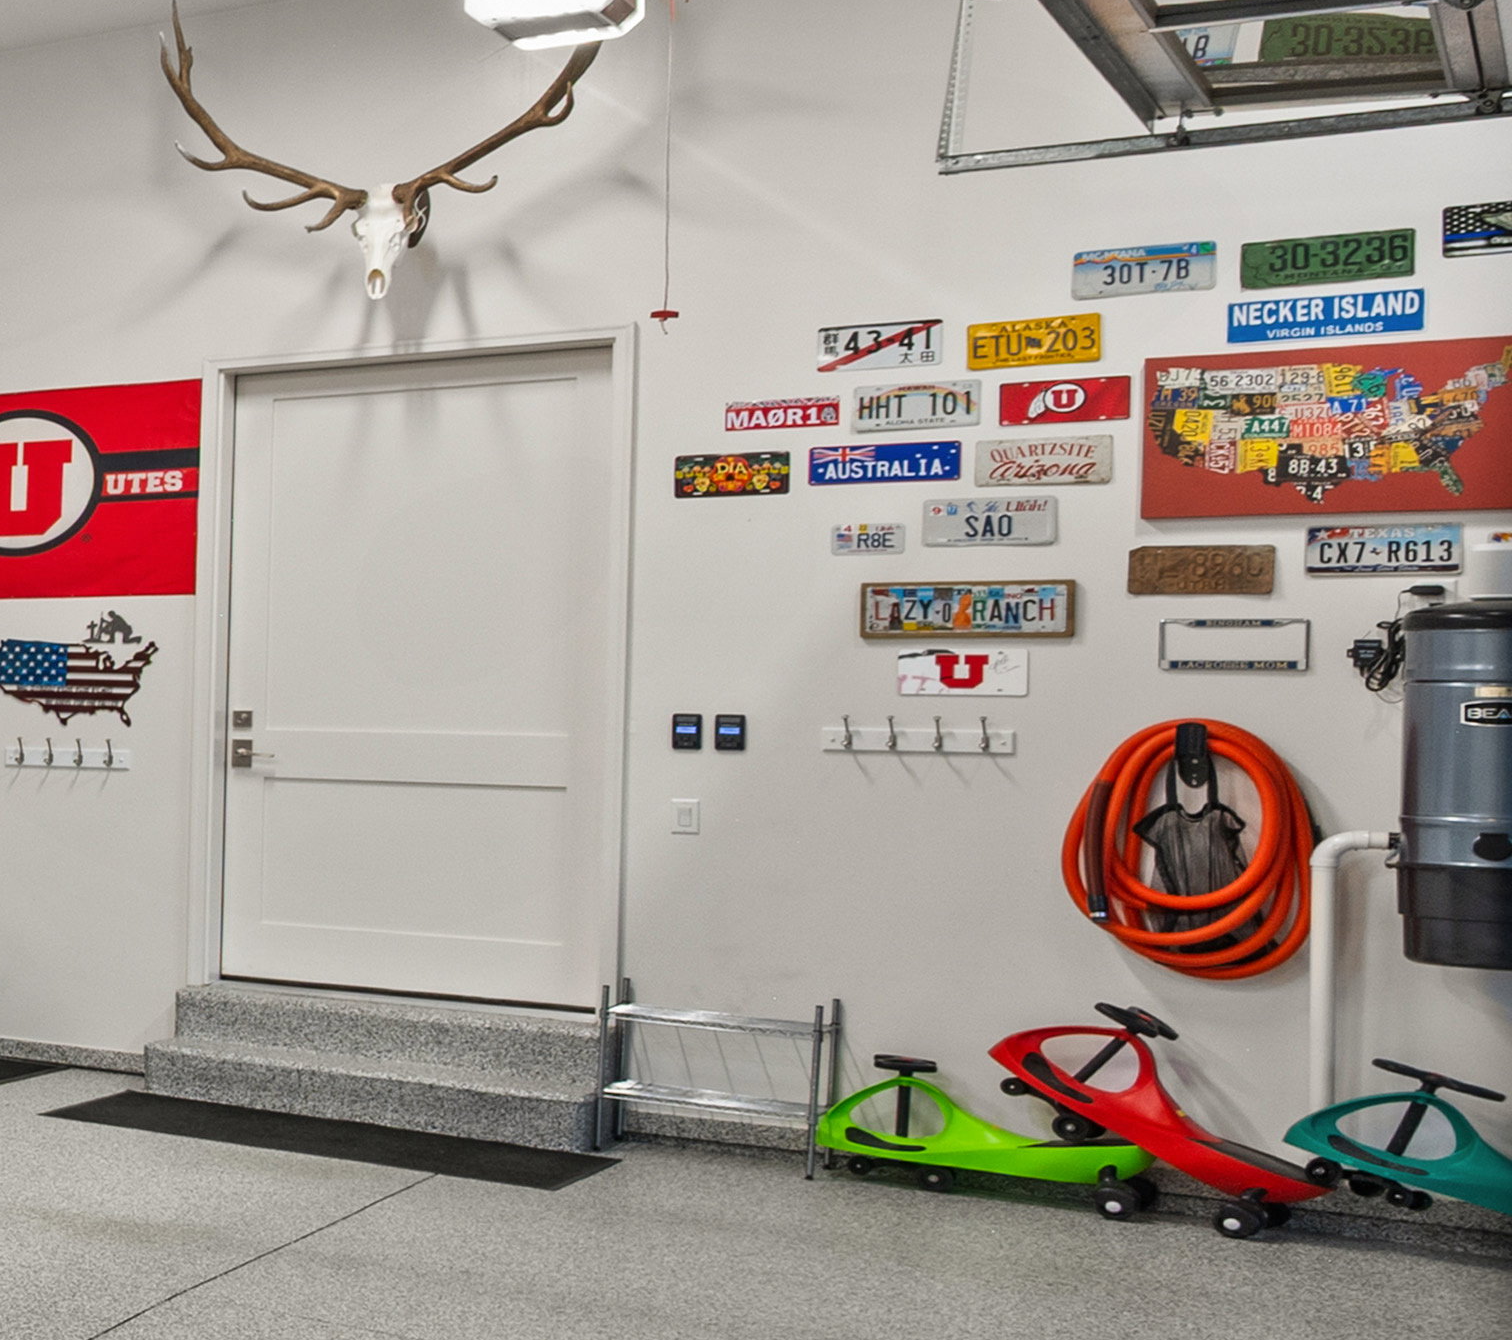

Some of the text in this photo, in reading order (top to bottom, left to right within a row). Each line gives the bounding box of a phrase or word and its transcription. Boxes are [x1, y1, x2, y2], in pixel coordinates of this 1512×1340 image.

[1269, 234, 1409, 272] 30-3236
[1233, 291, 1420, 327] NECKER ISLAND
[1000, 321, 1068, 333] ALASKA
[1267, 321, 1384, 338] VIRGIN ISLANDS
[973, 327, 1095, 359] ETU 203
[858, 391, 972, 419] HHT 101
[1050, 389, 1078, 409] U
[917, 417, 945, 425] STATE
[990, 443, 1097, 463] QUARTZSITE
[825, 459, 943, 480] AUSTRALIA
[105, 470, 184, 495] UTES
[1349, 527, 1415, 539] TEXAS
[1319, 540, 1453, 564] CX7 R613
[874, 598, 933, 621] LAZY
[972, 599, 1055, 624] RANCH
[935, 655, 989, 689] U
